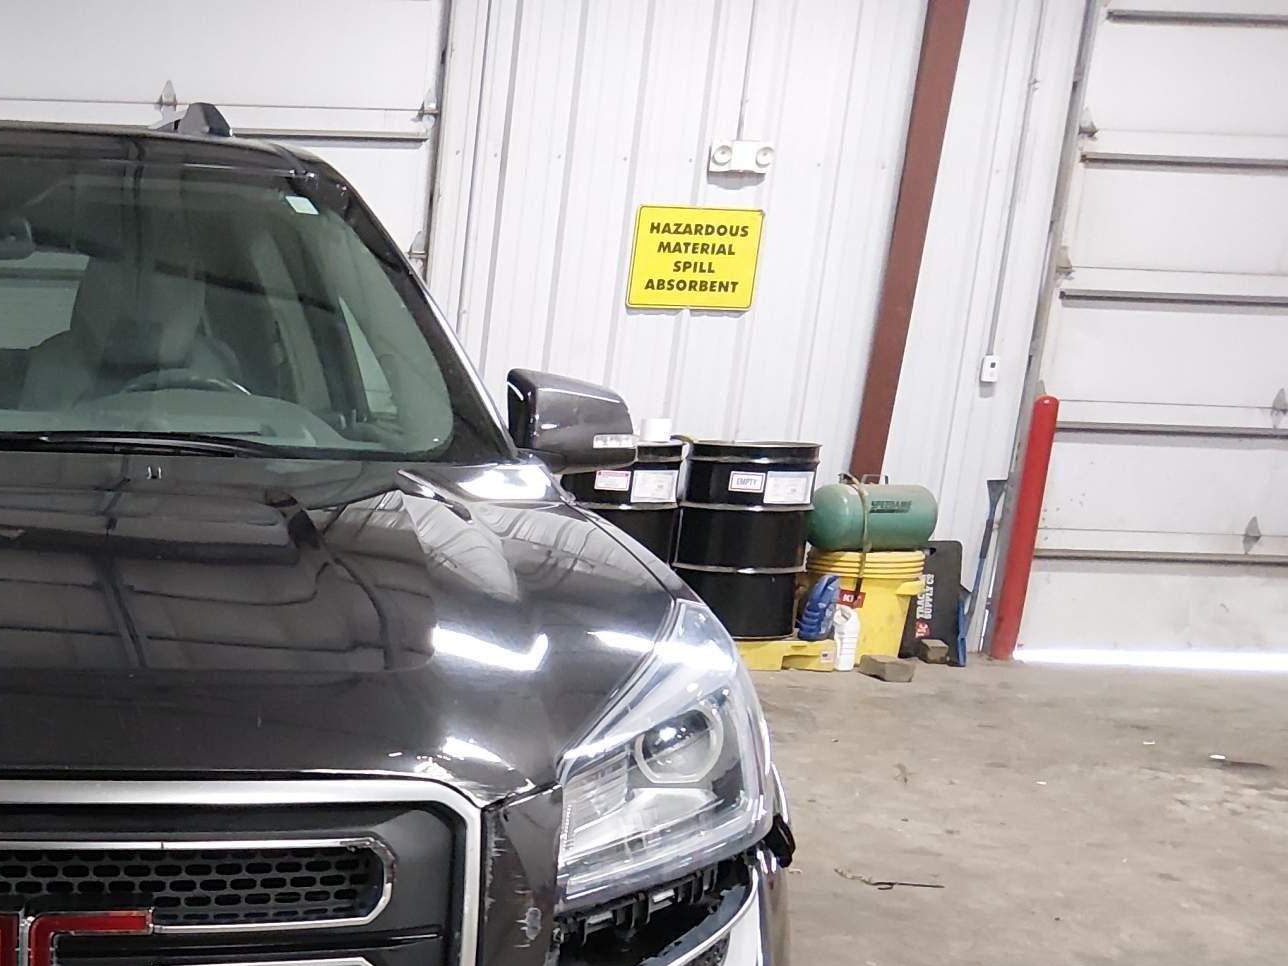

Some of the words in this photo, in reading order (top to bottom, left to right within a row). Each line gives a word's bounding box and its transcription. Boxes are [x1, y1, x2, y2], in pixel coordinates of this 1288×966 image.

[649, 222, 749, 237] HAZARDOUS
[657, 241, 735, 256] MATERIAL
[672, 260, 715, 274] SPILL
[644, 279, 739, 293] ABSORBENT
[736, 477, 757, 486] EMPTY
